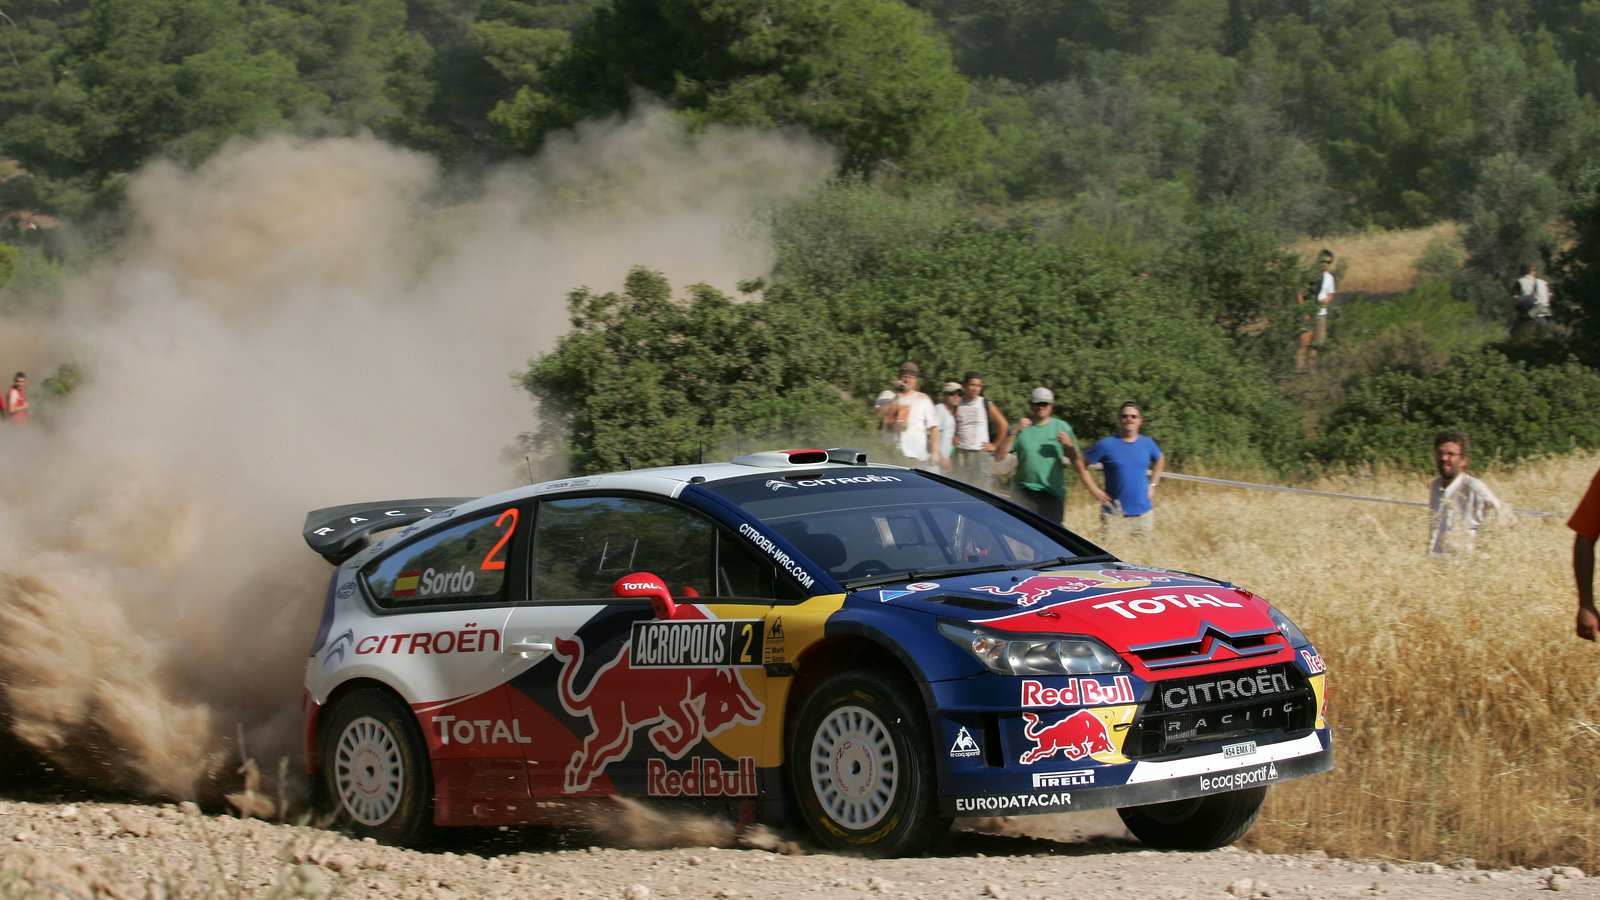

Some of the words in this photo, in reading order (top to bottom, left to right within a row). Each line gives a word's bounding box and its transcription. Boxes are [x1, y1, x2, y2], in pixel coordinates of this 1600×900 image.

[797, 474, 902, 488] CITROËN
[480, 507, 520, 570] 2
[739, 523, 815, 589] CITROEN-WRC.COM
[420, 566, 474, 595] Sordo
[622, 582, 660, 590] TOTAL
[1091, 593, 1244, 619] TOTAL
[355, 622, 499, 655] CITROËN
[635, 624, 726, 664] ACROPOLIS
[740, 624, 753, 663] 2
[1021, 678, 1080, 707] Red
[1080, 675, 1135, 704] Bull
[1164, 669, 1290, 709] CITROËN
[431, 715, 532, 745] TOTAL
[1168, 702, 1293, 731] RACING
[1225, 747, 1235, 756] 454
[1236, 744, 1248, 755] EMX
[648, 756, 701, 796] Red
[702, 756, 758, 796] Bull
[1032, 769, 1095, 788] PIRELLI
[1200, 776, 1210, 790] le
[1211, 775, 1233, 790] coq
[1234, 766, 1267, 788] sportif
[956, 793, 1072, 811] EURODATACAR
